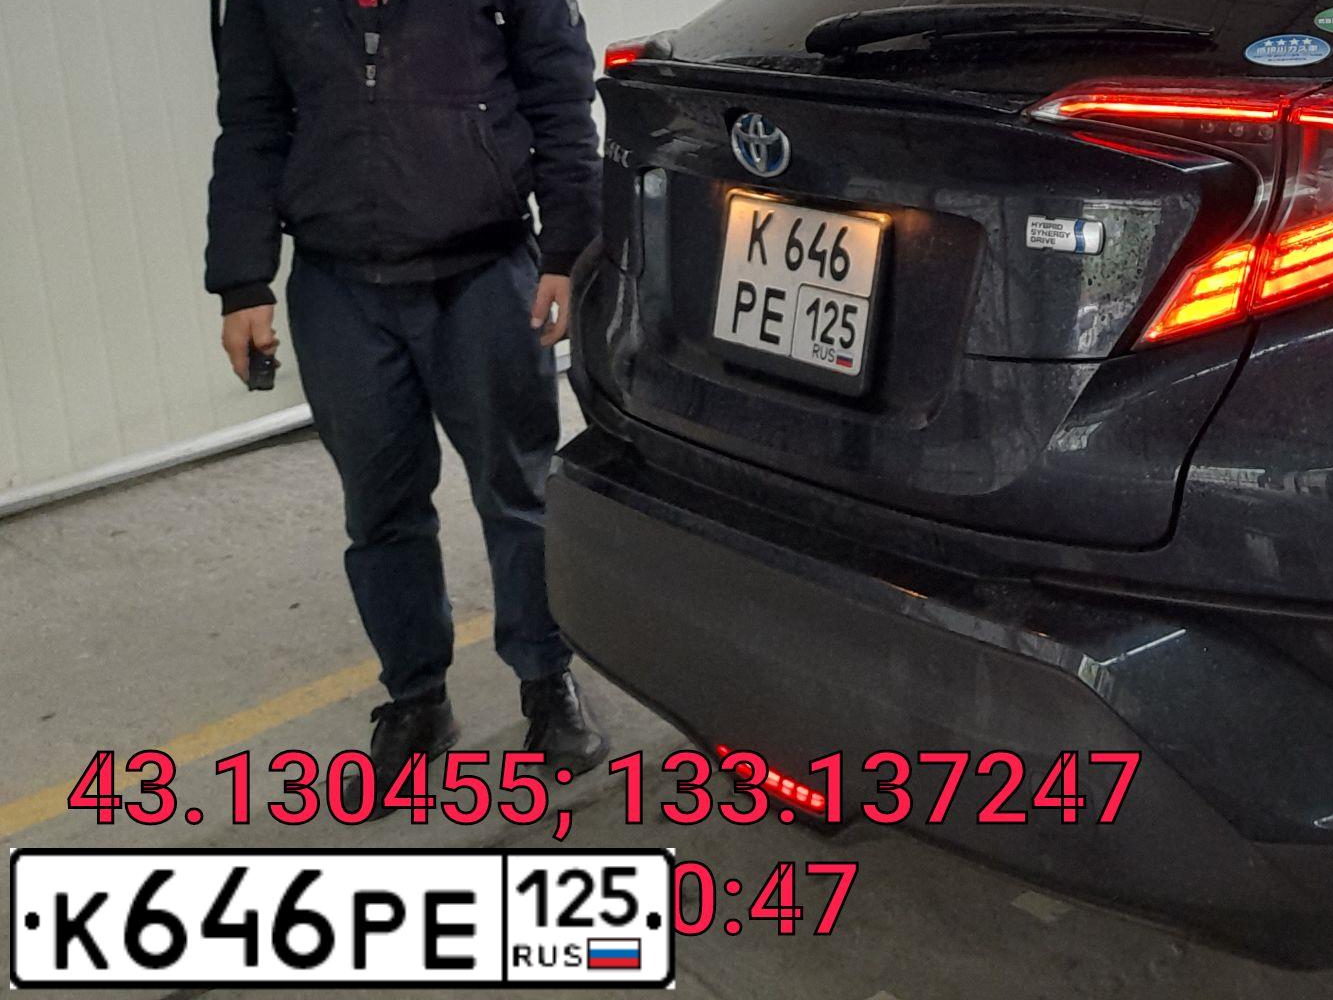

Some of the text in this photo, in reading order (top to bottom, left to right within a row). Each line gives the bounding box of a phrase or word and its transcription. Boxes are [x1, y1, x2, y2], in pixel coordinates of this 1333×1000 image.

[1030, 228, 1071, 239] SYNERGY
[1031, 221, 1064, 231] HYBRID
[747, 209, 851, 282] К 646
[1030, 235, 1057, 245] DRIVE
[731, 280, 787, 346] РЕ
[805, 297, 859, 350] 125
[811, 343, 836, 364] RUS
